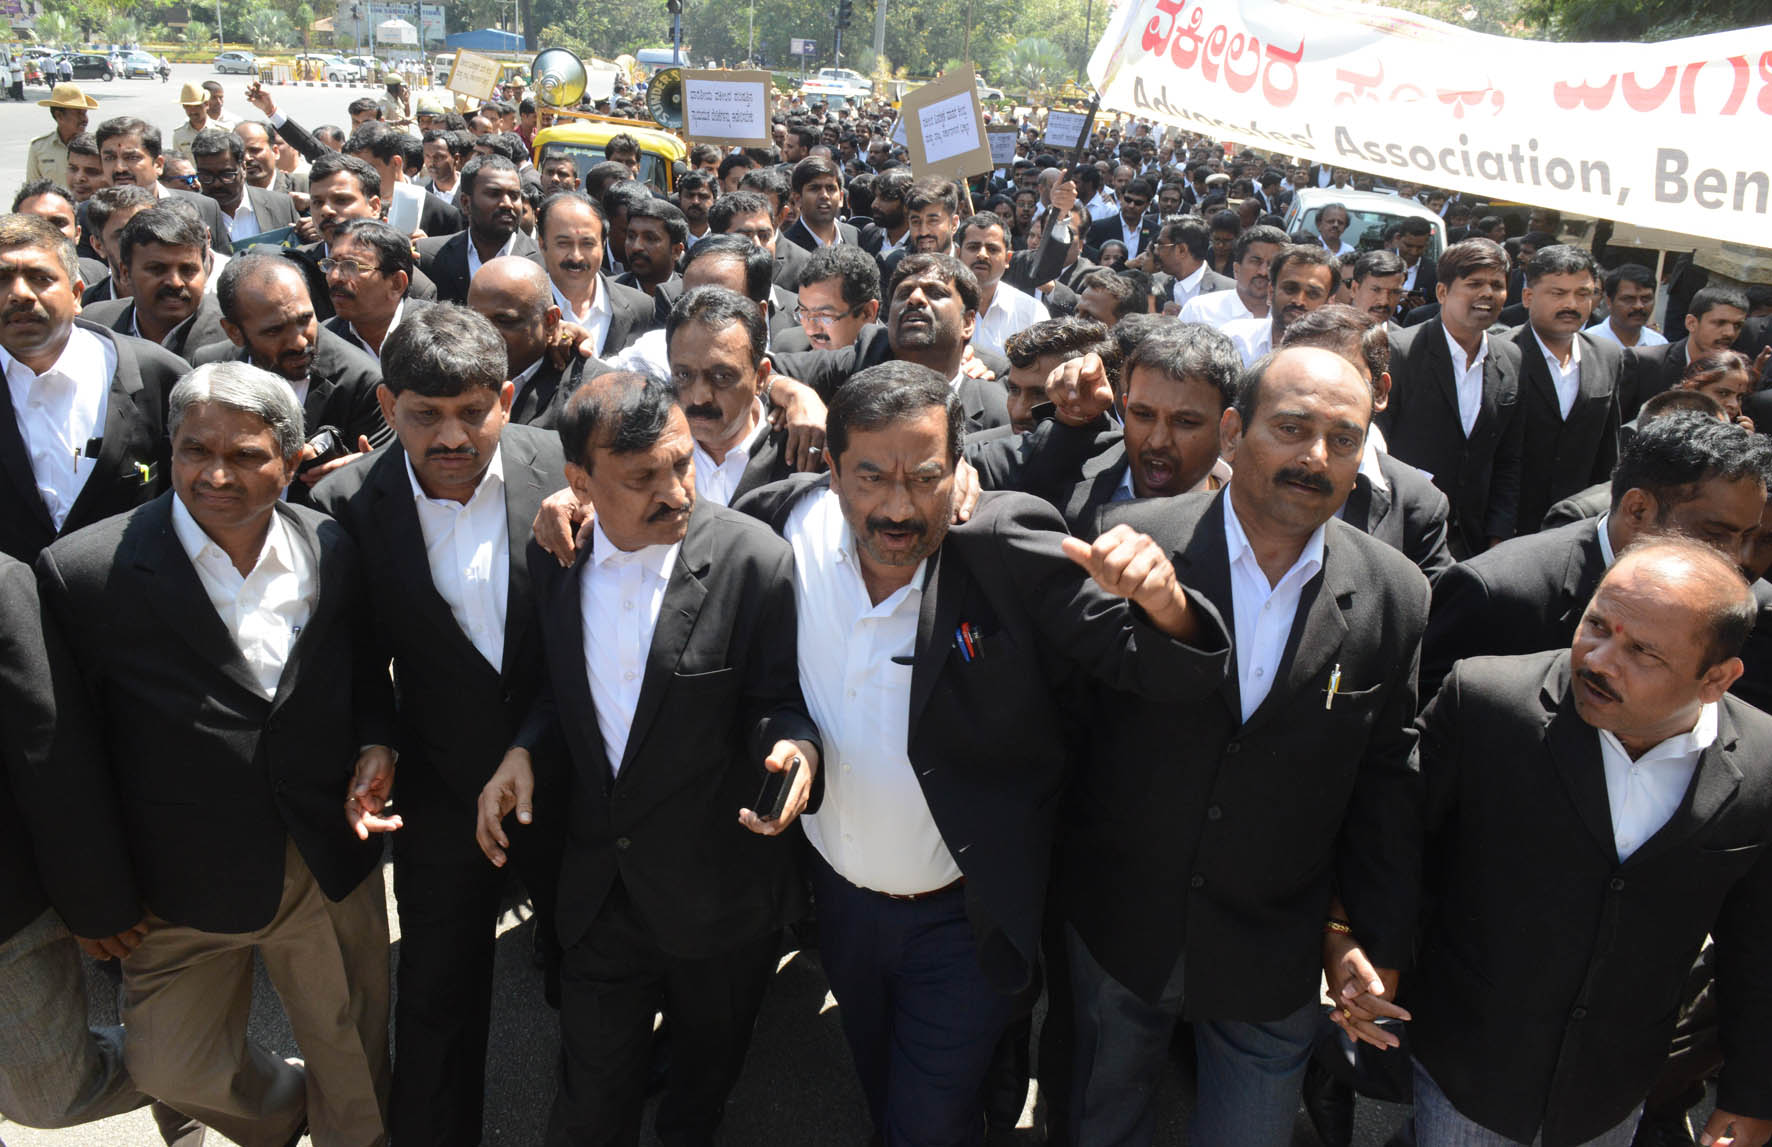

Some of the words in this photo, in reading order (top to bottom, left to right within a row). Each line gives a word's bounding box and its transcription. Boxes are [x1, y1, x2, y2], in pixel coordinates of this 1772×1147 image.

[1141, 0, 1306, 108] ವಕೀಲರ
[1334, 126, 1631, 206] Association,
[1655, 147, 1770, 214] Ben
